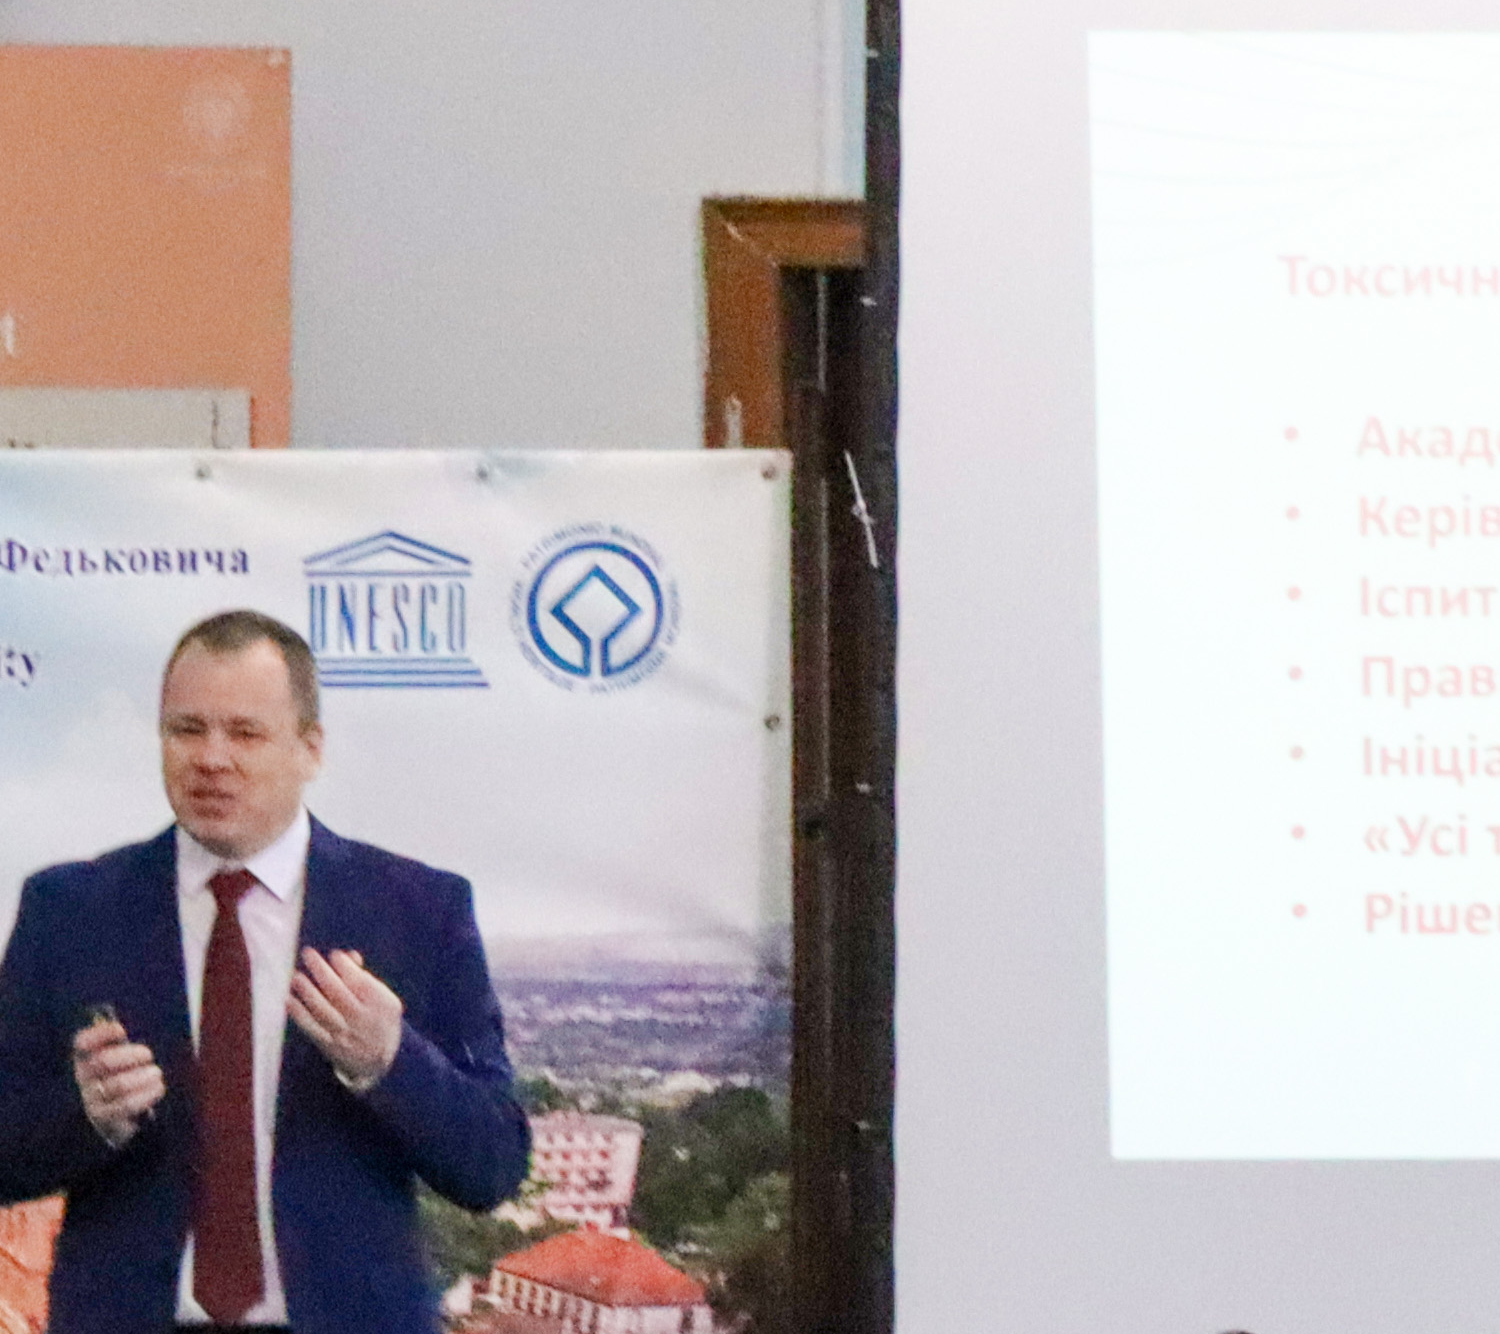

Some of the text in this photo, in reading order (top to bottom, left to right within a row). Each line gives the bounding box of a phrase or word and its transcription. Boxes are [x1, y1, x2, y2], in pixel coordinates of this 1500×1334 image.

[309, 582, 468, 654] UNESCO
[1360, 578, 1497, 618] Іспит
[1365, 814, 1467, 856] «Усі
